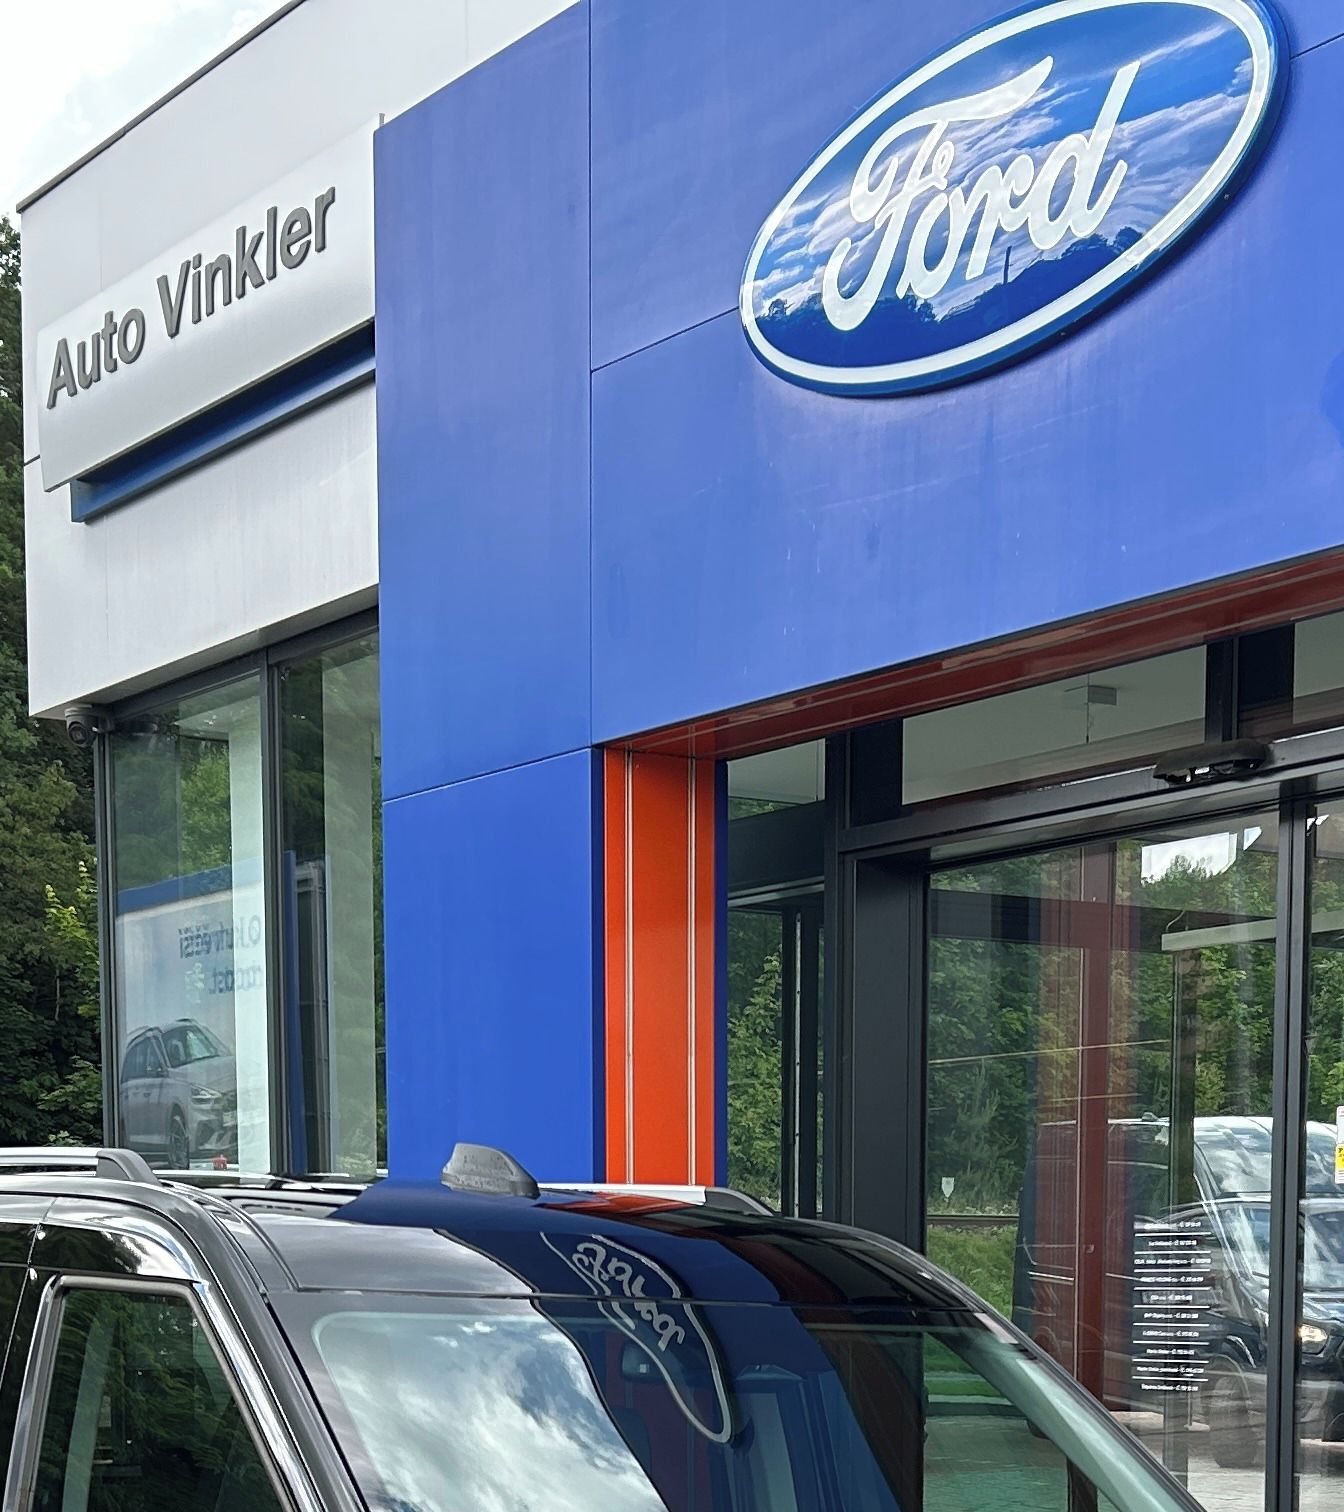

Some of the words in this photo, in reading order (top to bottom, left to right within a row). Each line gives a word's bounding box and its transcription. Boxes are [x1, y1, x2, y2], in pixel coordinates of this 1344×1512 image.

[45, 306, 146, 410] Auto
[156, 186, 336, 339] Vinkler
[822, 55, 1141, 331] Ford
